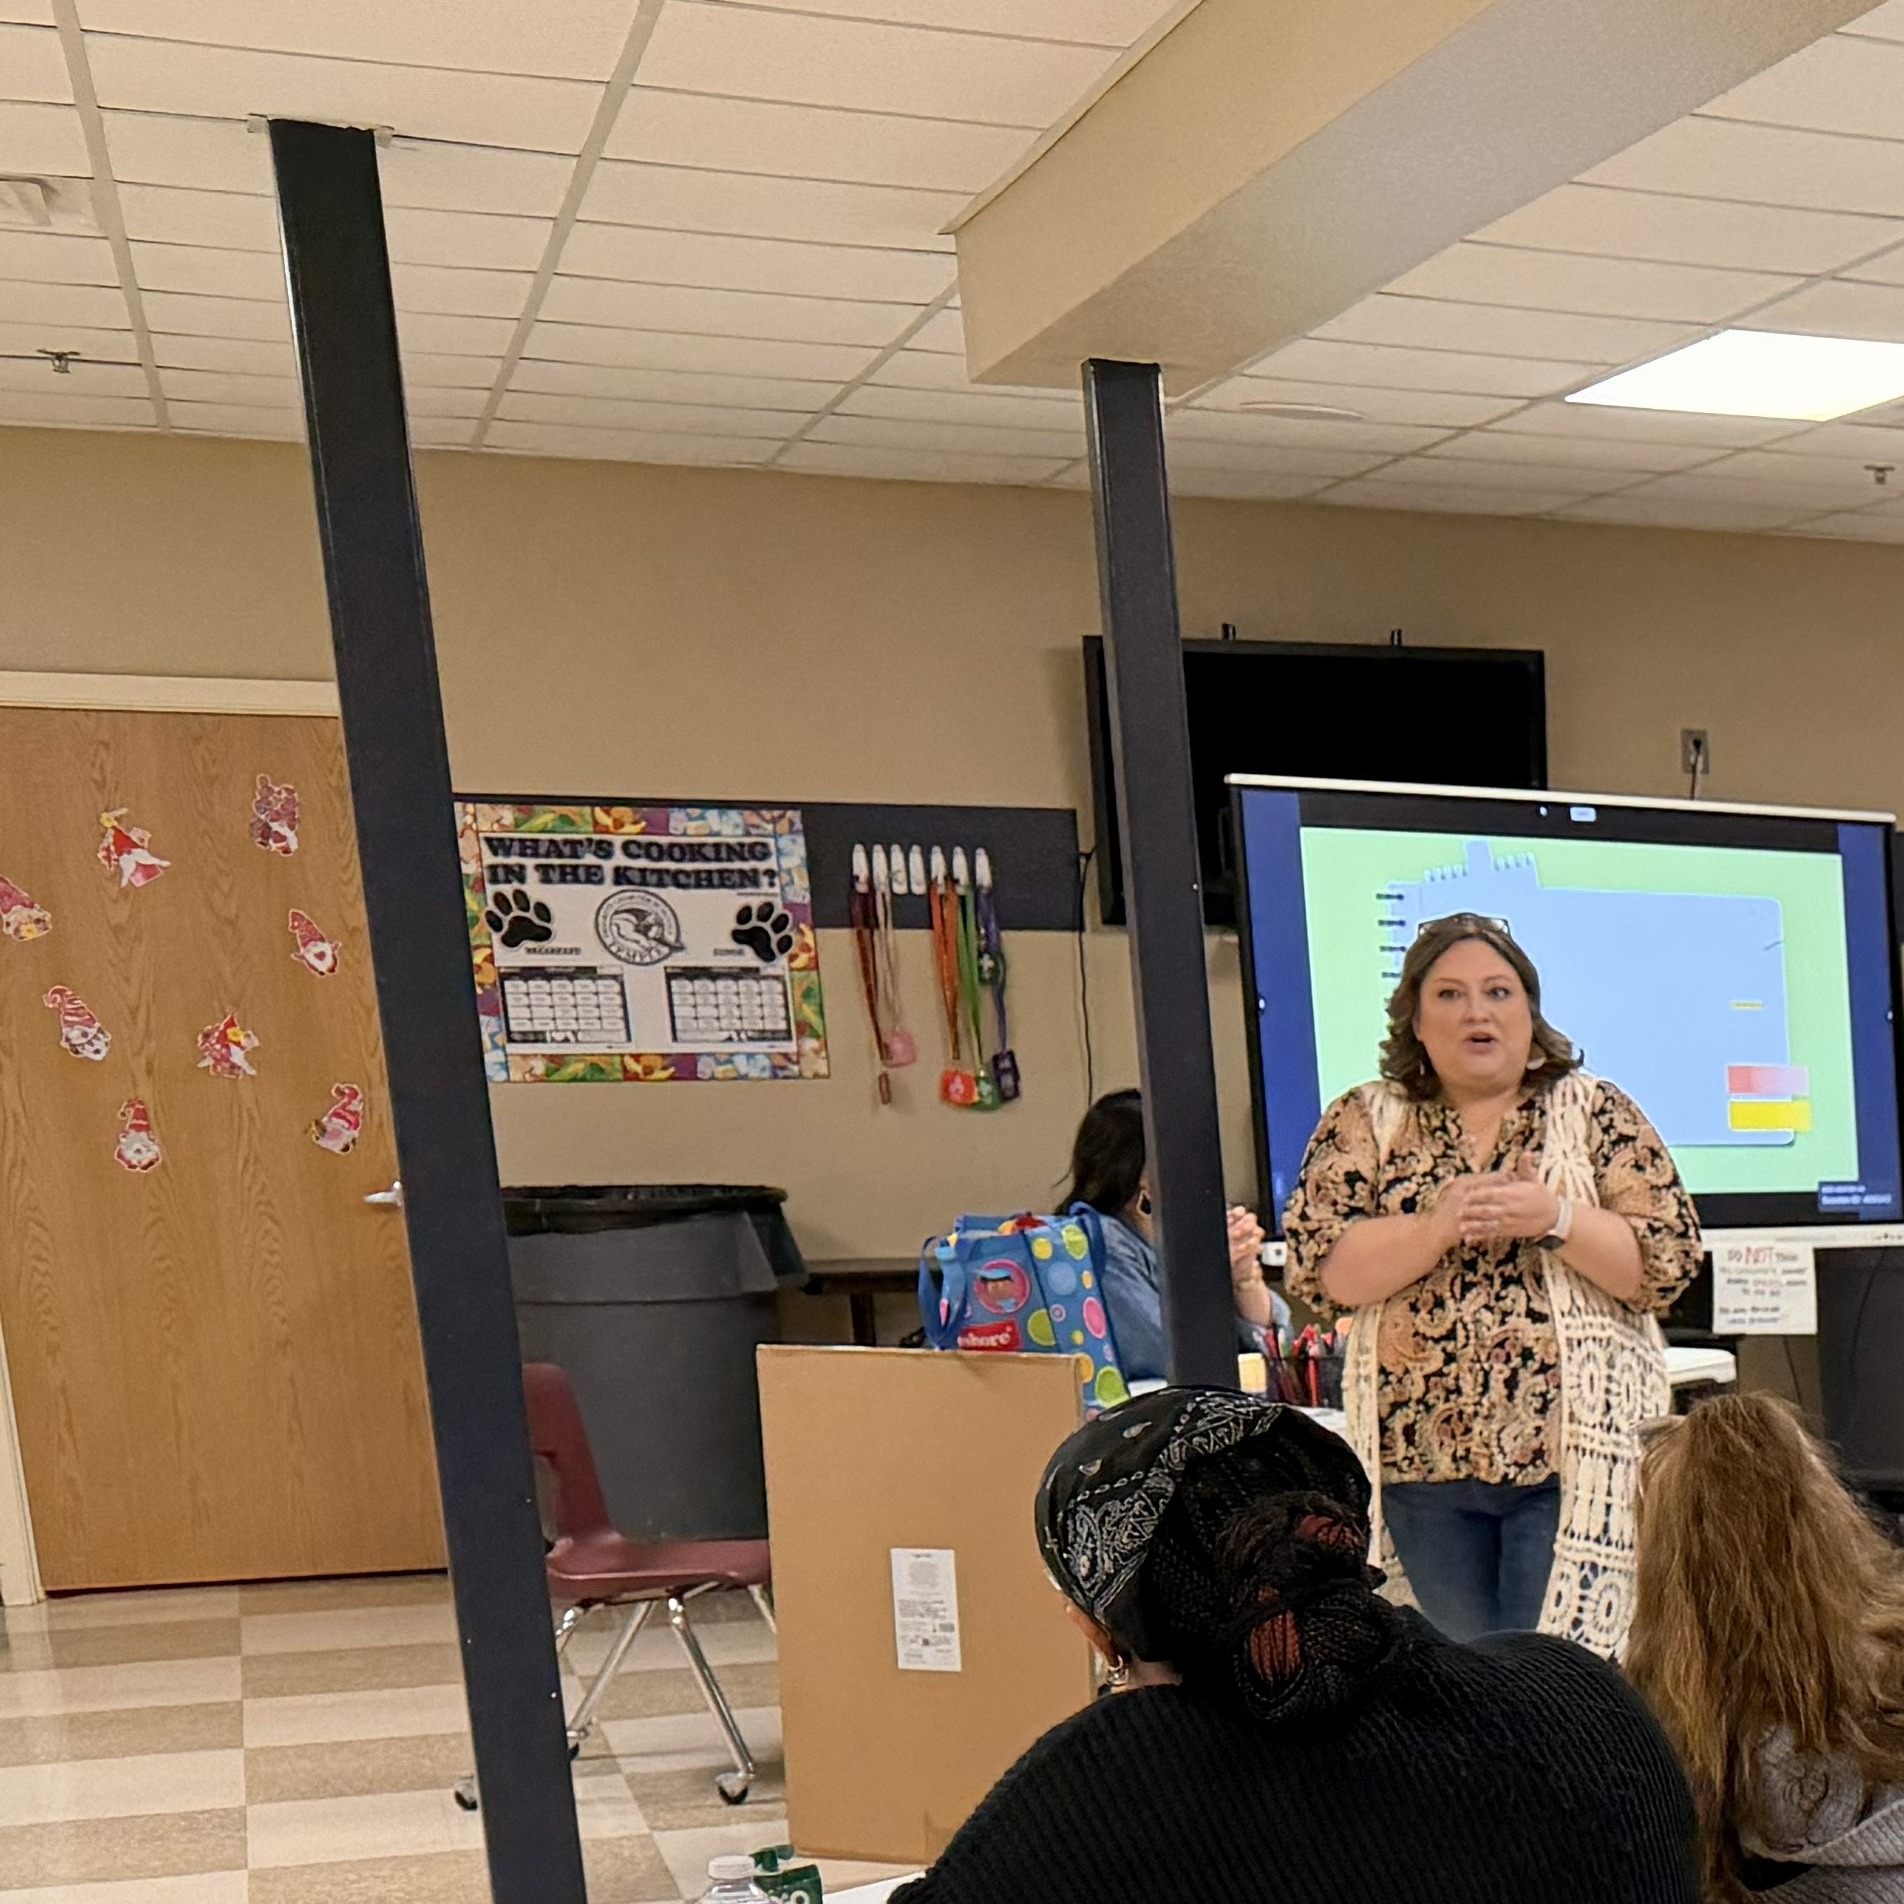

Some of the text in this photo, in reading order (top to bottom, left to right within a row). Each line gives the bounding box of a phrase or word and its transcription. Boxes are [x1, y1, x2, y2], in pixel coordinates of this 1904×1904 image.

[483, 836, 773, 863] WHAT'S COOKING
[485, 863, 778, 889] IN THE KITCHEN?
